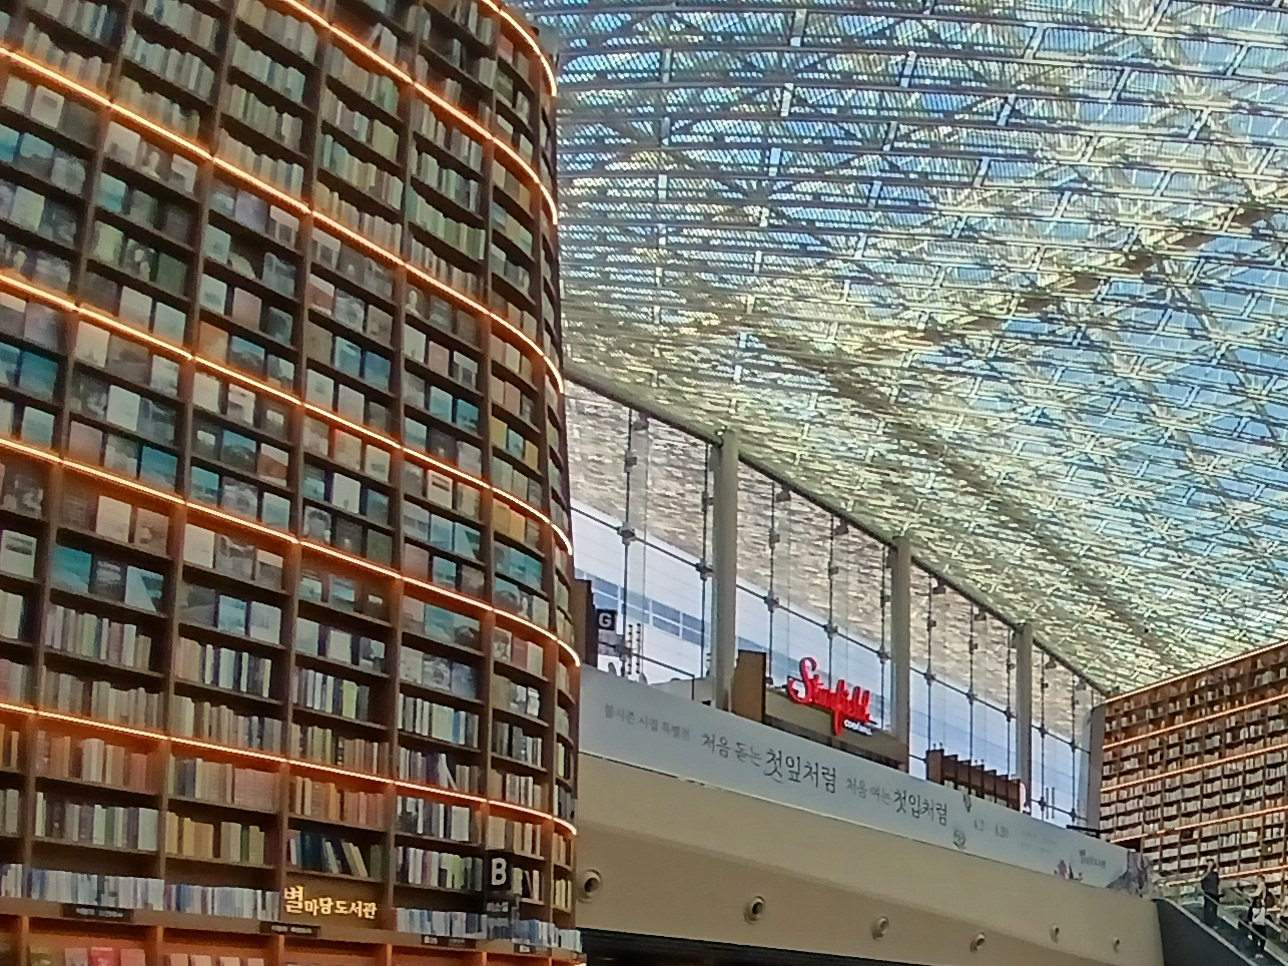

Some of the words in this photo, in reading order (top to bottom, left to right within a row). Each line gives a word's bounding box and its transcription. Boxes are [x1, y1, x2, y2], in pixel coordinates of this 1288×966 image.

[599, 612, 612, 628] G
[701, 732, 732, 759] 처음
[845, 777, 869, 799] 처음
[491, 857, 507, 886] B
[283, 885, 378, 920] 별마당도서관
